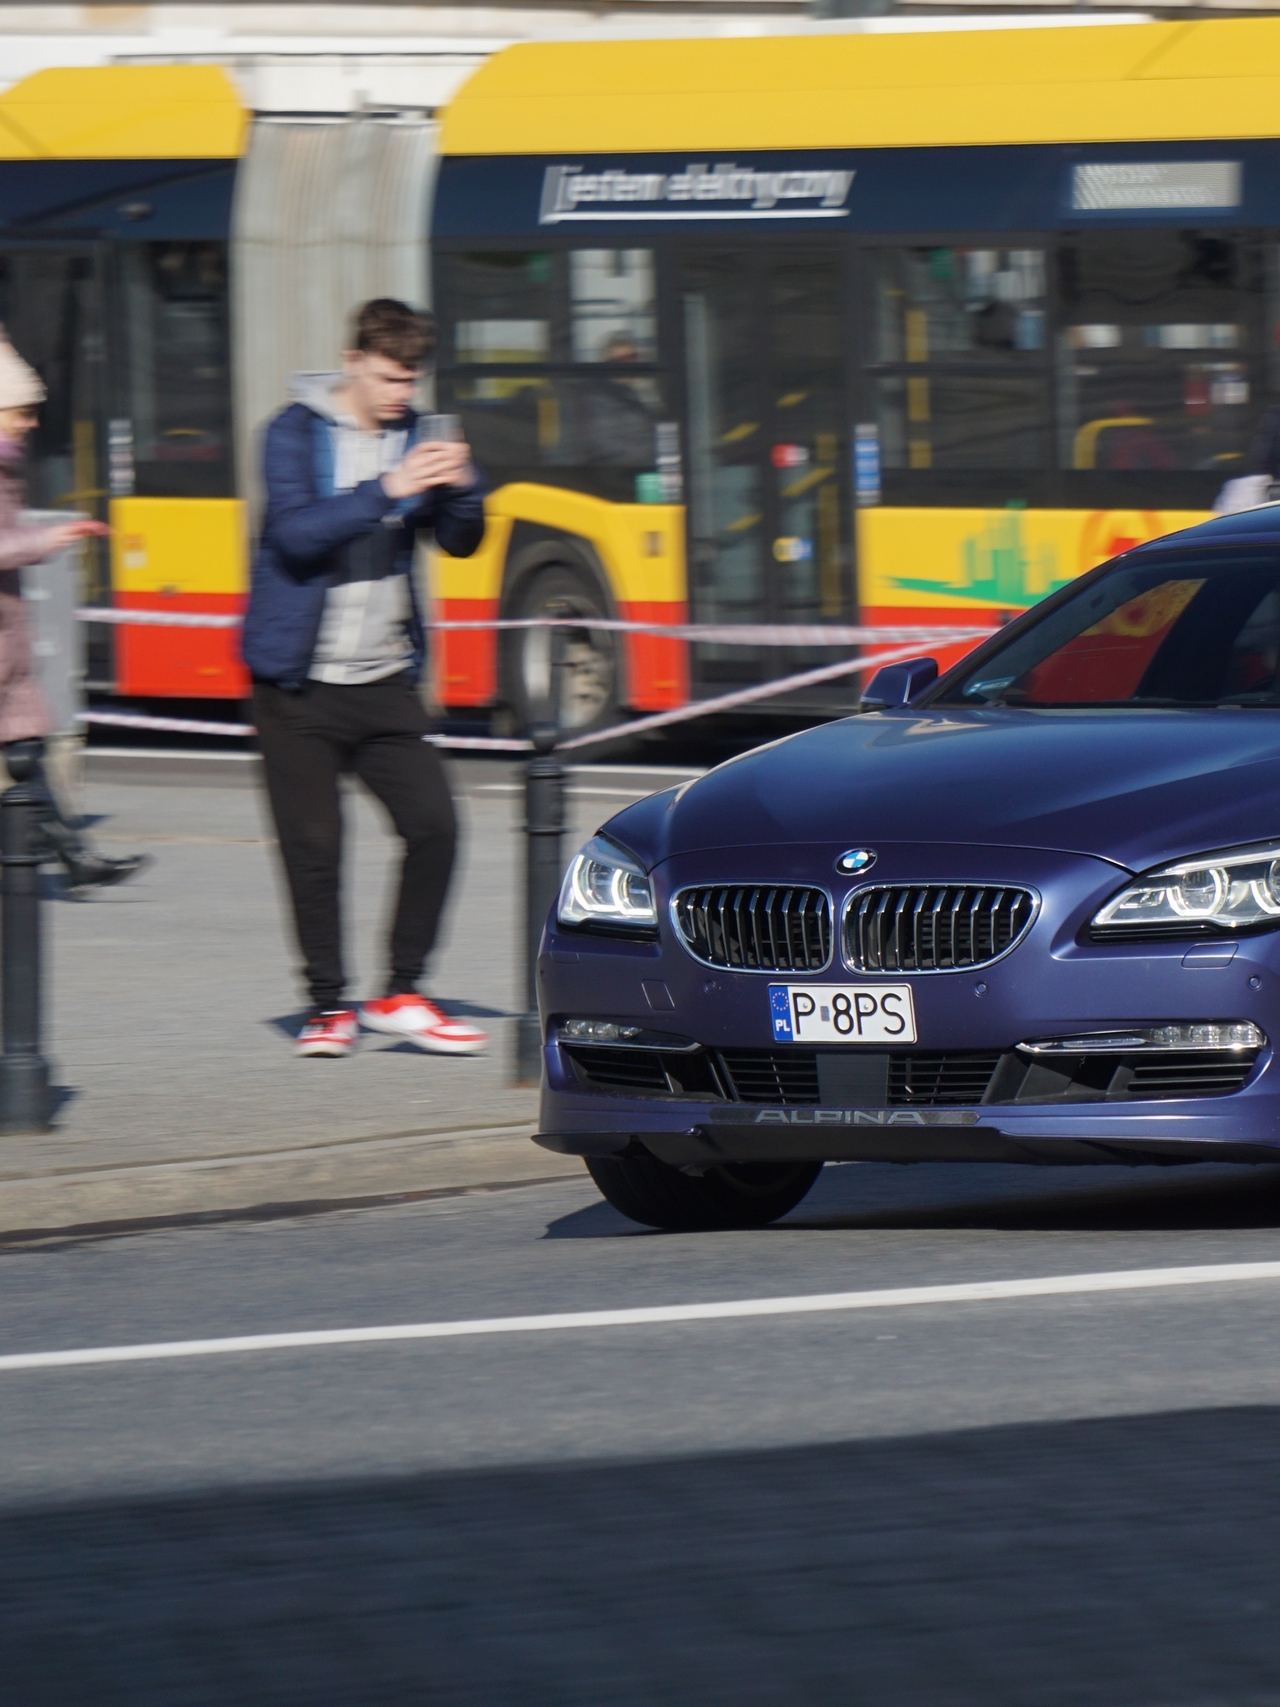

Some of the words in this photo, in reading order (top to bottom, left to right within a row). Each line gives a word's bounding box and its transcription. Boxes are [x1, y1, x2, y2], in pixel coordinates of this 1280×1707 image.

[550, 164, 668, 211] jestem
[666, 163, 855, 209] elektryczny
[775, 1019, 791, 1032] PL
[754, 1110, 926, 1125] ALPINA
